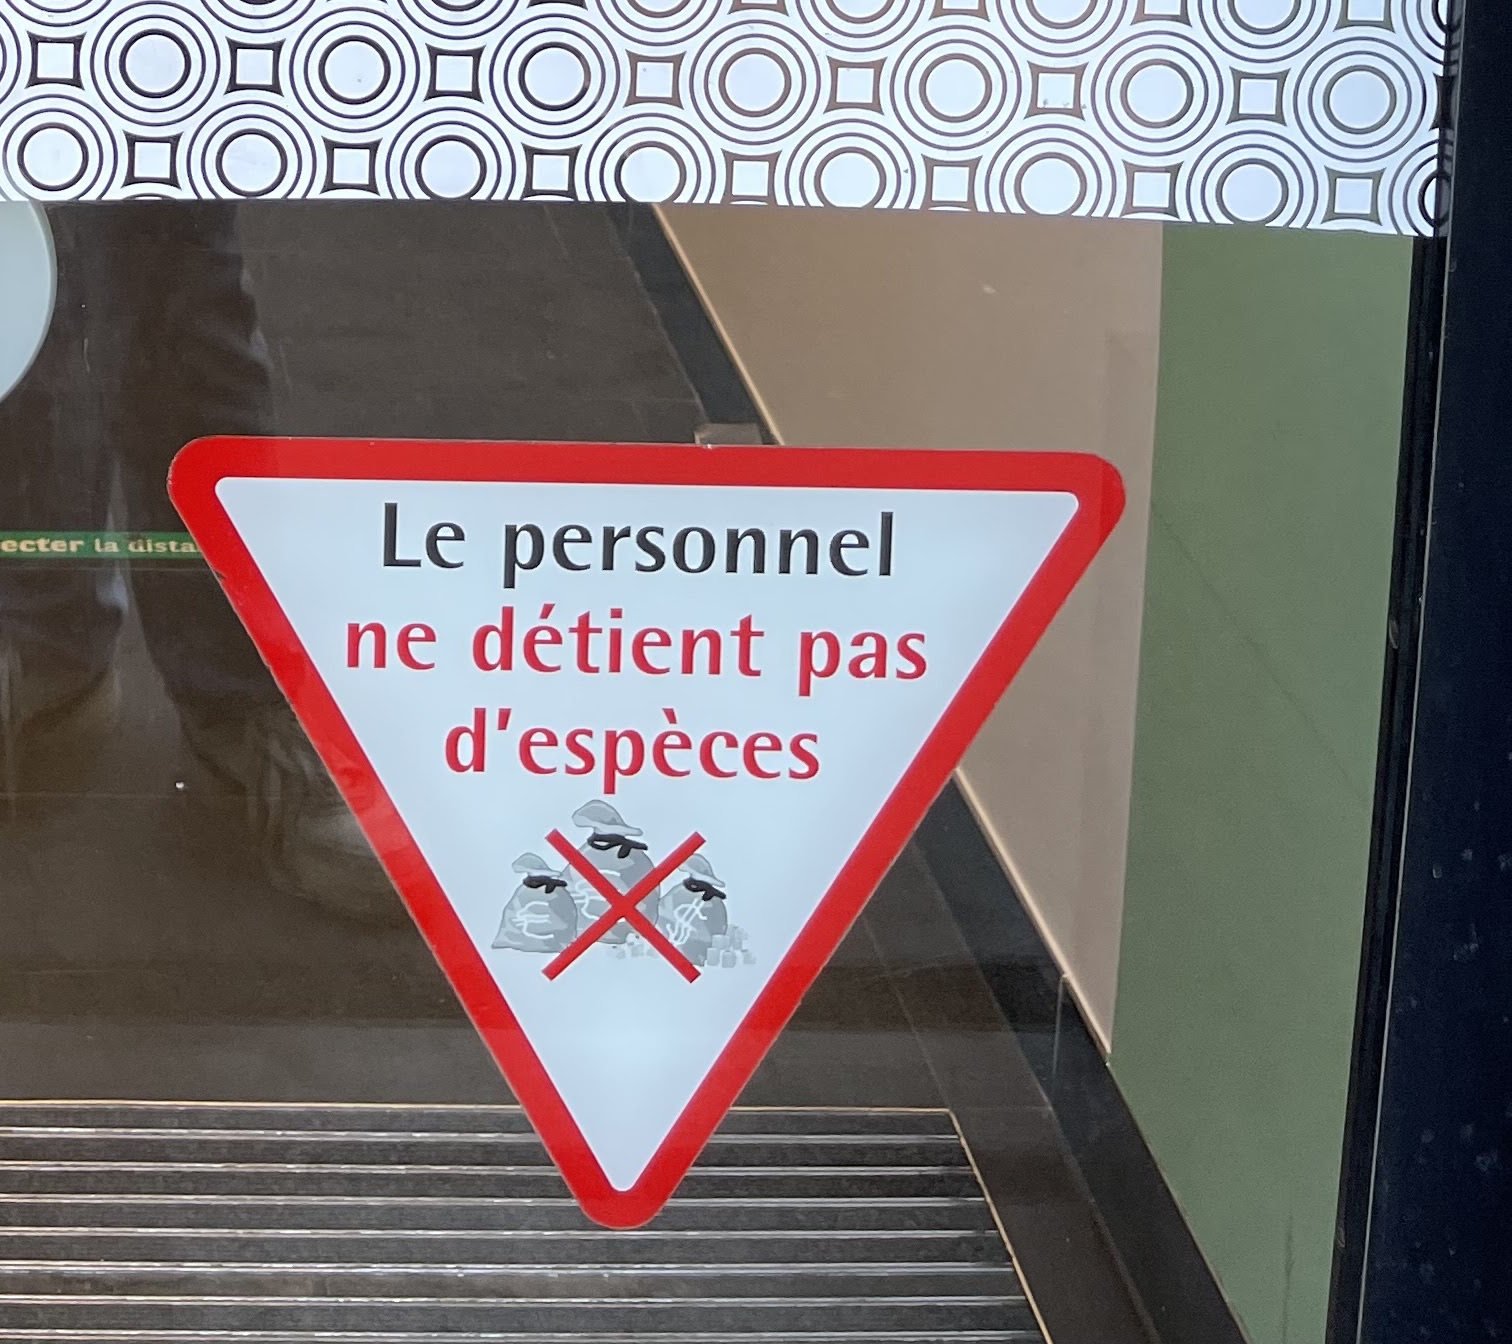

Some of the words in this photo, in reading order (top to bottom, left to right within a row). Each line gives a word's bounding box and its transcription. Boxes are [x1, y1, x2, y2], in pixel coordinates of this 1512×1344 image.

[94, 537, 119, 554] la
[381, 502, 467, 570] Le
[501, 510, 896, 588] personnel
[345, 620, 438, 671] ne
[472, 602, 762, 678] détient
[797, 632, 929, 698] pas
[444, 707, 820, 796] d'espèces
